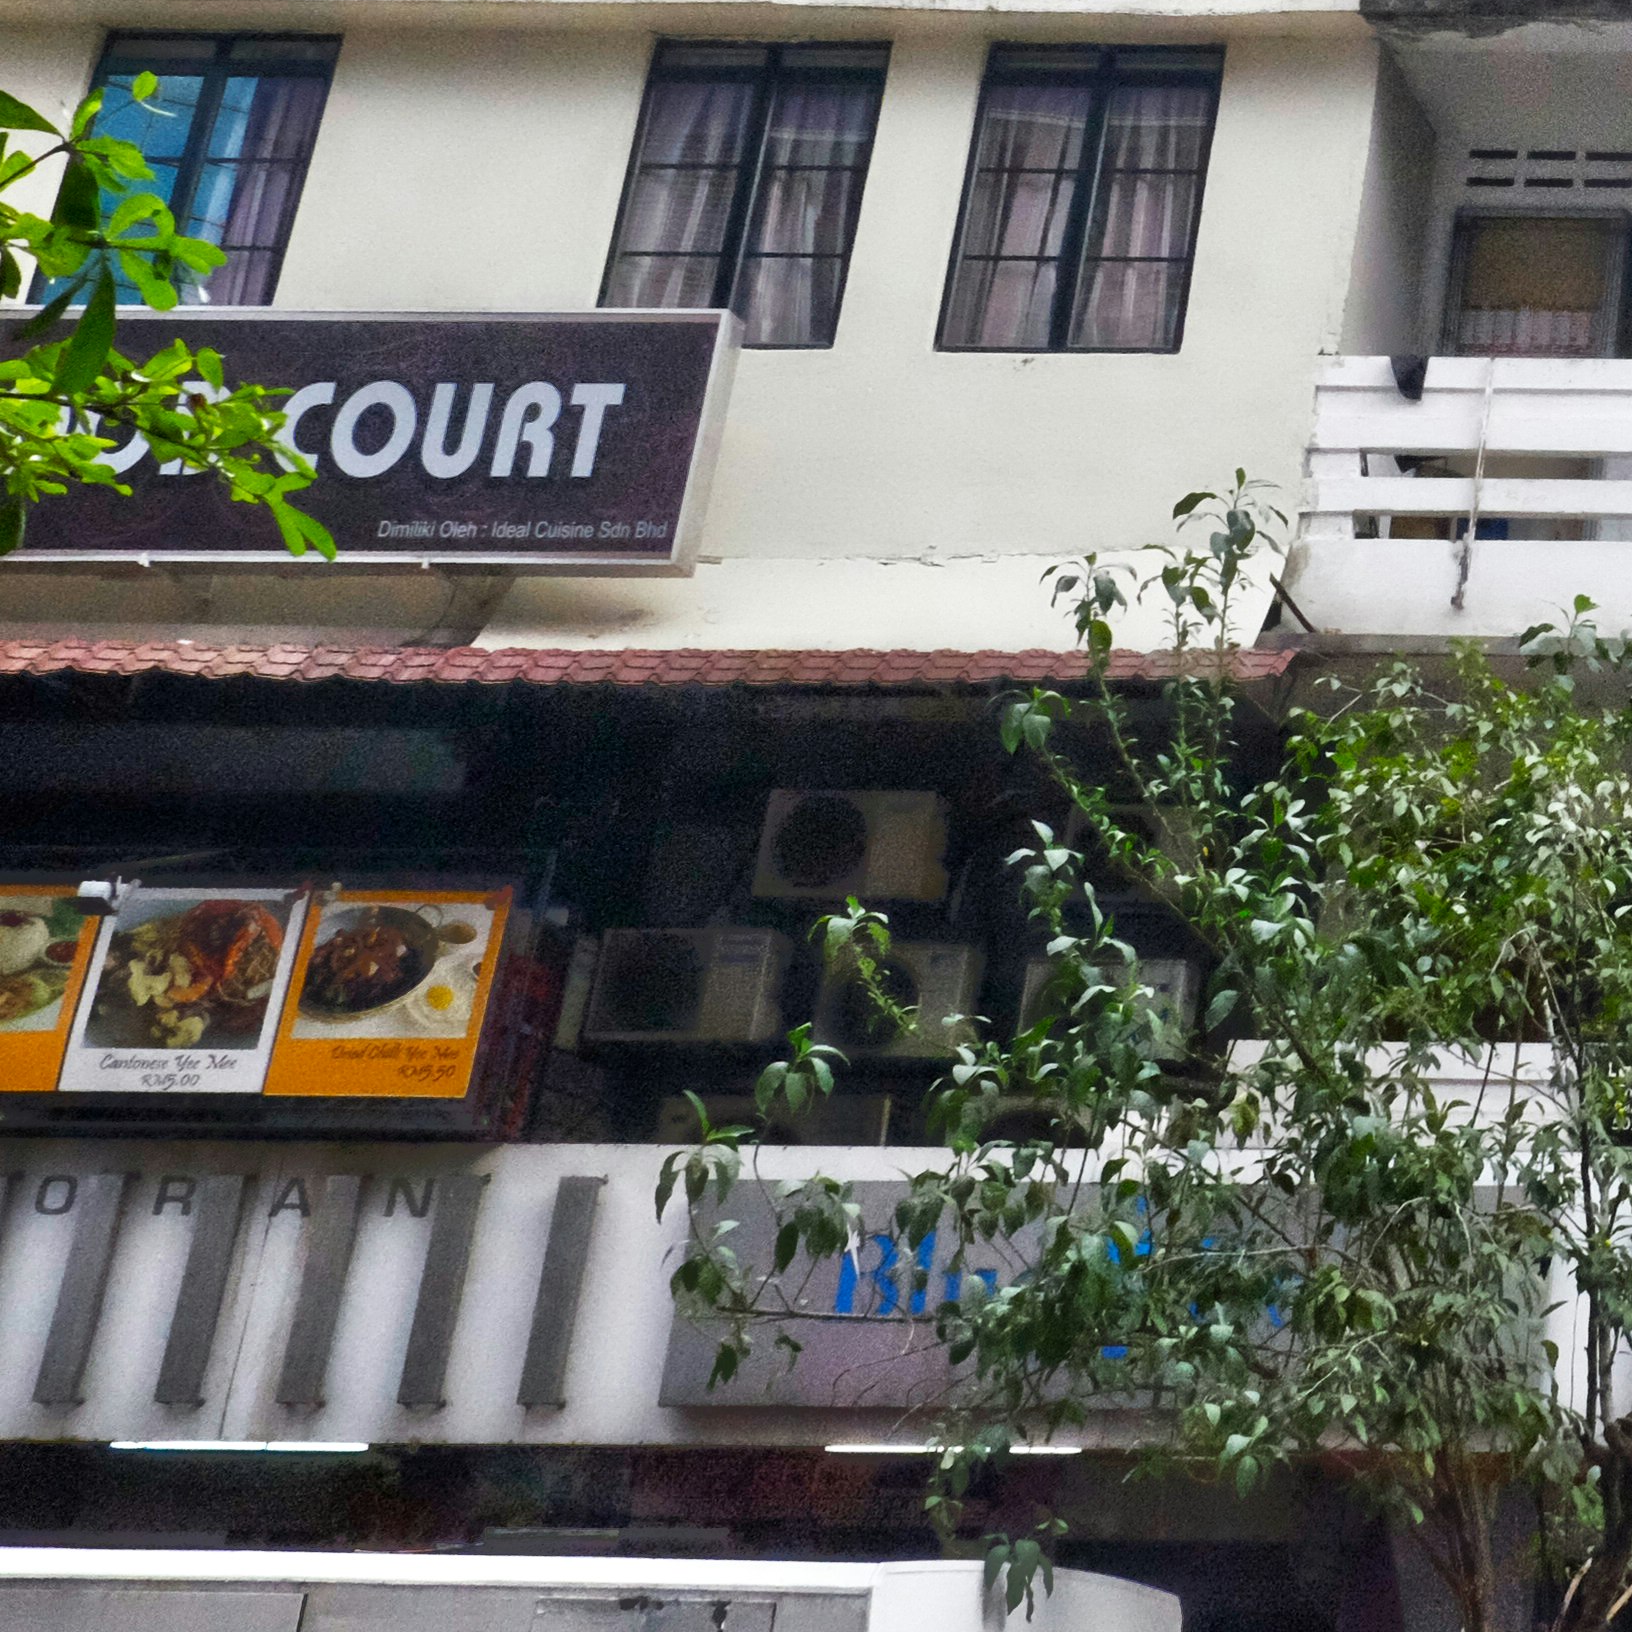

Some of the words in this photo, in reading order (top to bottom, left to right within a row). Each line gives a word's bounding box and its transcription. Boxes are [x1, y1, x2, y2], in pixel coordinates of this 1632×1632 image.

[272, 379, 627, 479] COURT
[377, 520, 435, 539] Dimiliki
[491, 520, 531, 539] Ideal
[534, 520, 595, 539] Cuisine
[598, 520, 631, 539] Sdn
[634, 520, 669, 539] Bhd
[98, 1053, 170, 1070] Cantonese
[174, 1054, 202, 1072] Yee
[205, 1054, 238, 1070] Mee
